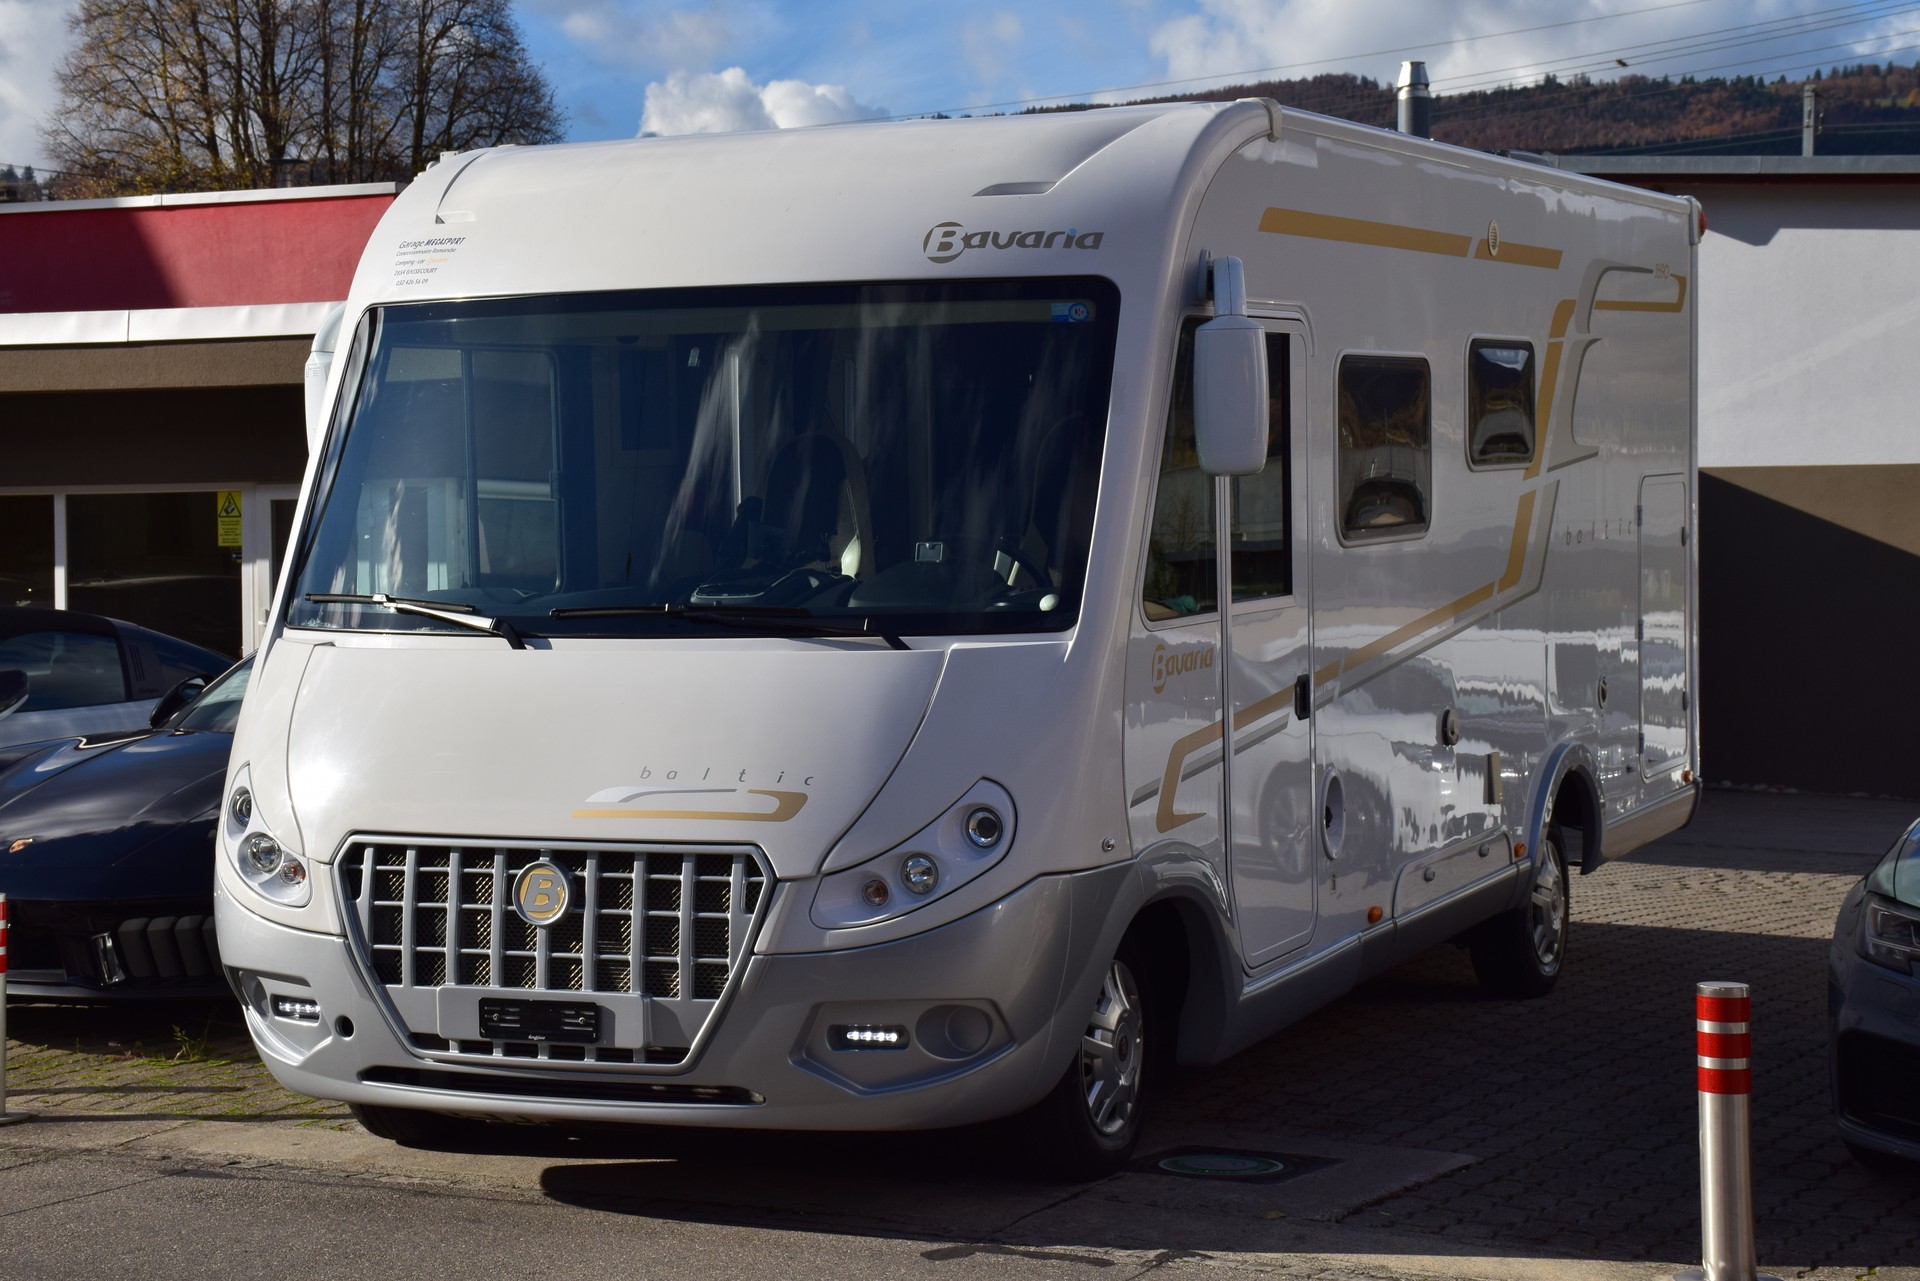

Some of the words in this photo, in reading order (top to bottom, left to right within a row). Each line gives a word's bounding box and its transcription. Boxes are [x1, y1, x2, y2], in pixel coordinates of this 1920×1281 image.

[399, 240, 425, 249] Garage
[923, 222, 1104, 264] Bavaria
[1565, 518, 1632, 546] baltic
[1151, 644, 1215, 695] Bavaria
[640, 766, 814, 787] baltic
[520, 869, 565, 917] B
